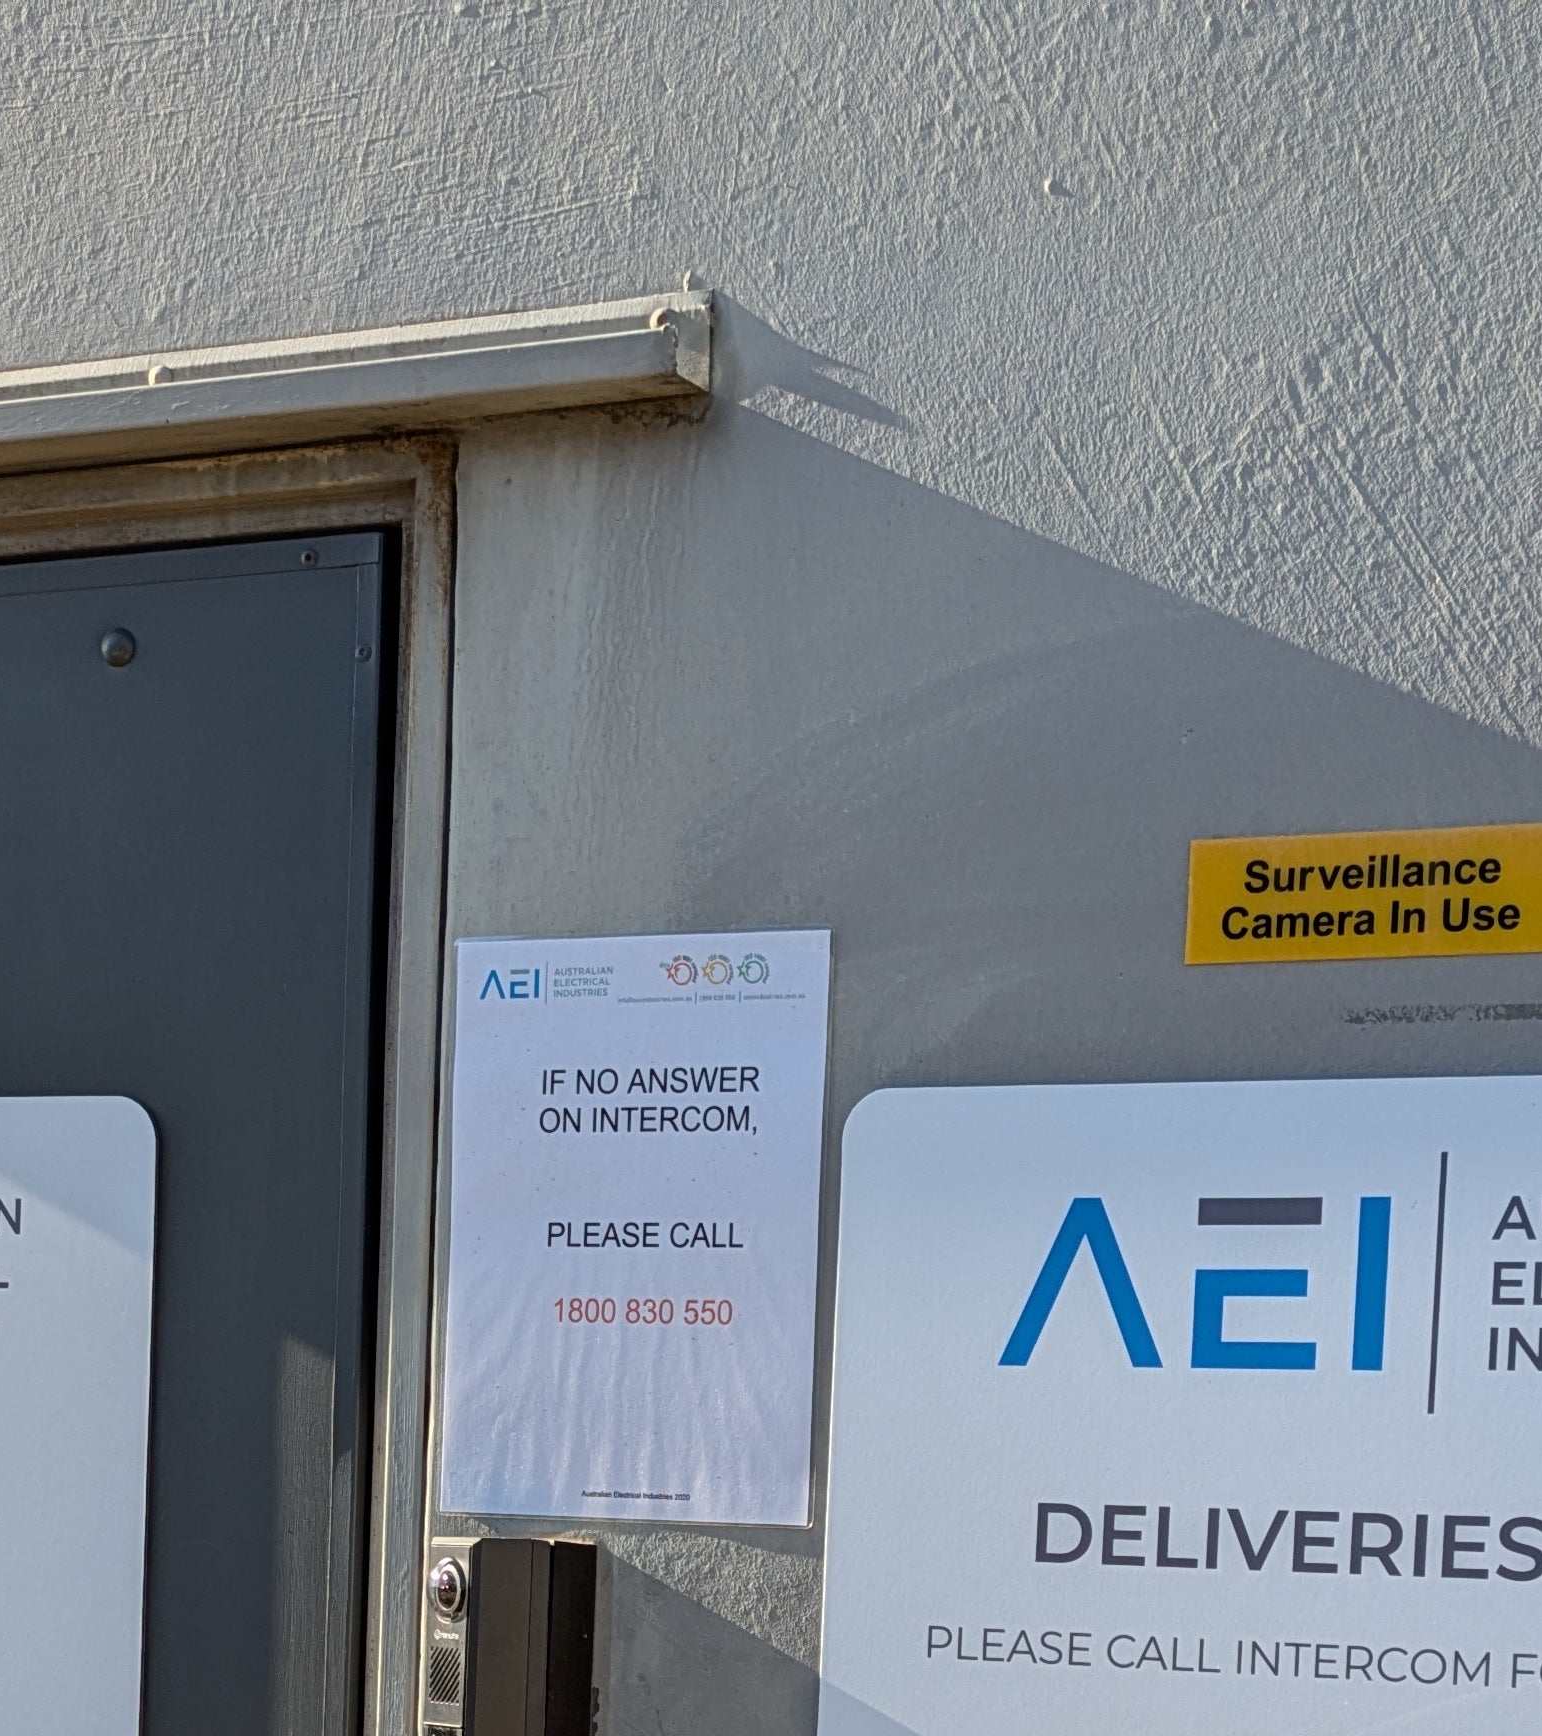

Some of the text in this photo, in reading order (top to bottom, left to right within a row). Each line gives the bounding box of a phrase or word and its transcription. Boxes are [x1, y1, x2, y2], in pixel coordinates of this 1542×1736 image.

[1244, 853, 1502, 894] Surveillance
[1221, 897, 1521, 941] Camera In Use
[479, 968, 540, 1000] AEI
[553, 966, 614, 977] AUSTRALIAN
[553, 977, 611, 988] ELECTRICAL
[553, 987, 609, 998] INDUSTRIES
[542, 1066, 760, 1096] IF NO ANSWER
[539, 1105, 757, 1136] ON INTERCOM,
[547, 1221, 744, 1249] PLEASE CALL
[997, 1196, 1392, 1372] AEI
[554, 1297, 733, 1326] 1800 830 550
[927, 1625, 1092, 1667] PLEASE
[1106, 1634, 1221, 1674] CALL
[1236, 1640, 1491, 1687] INTERCOM
